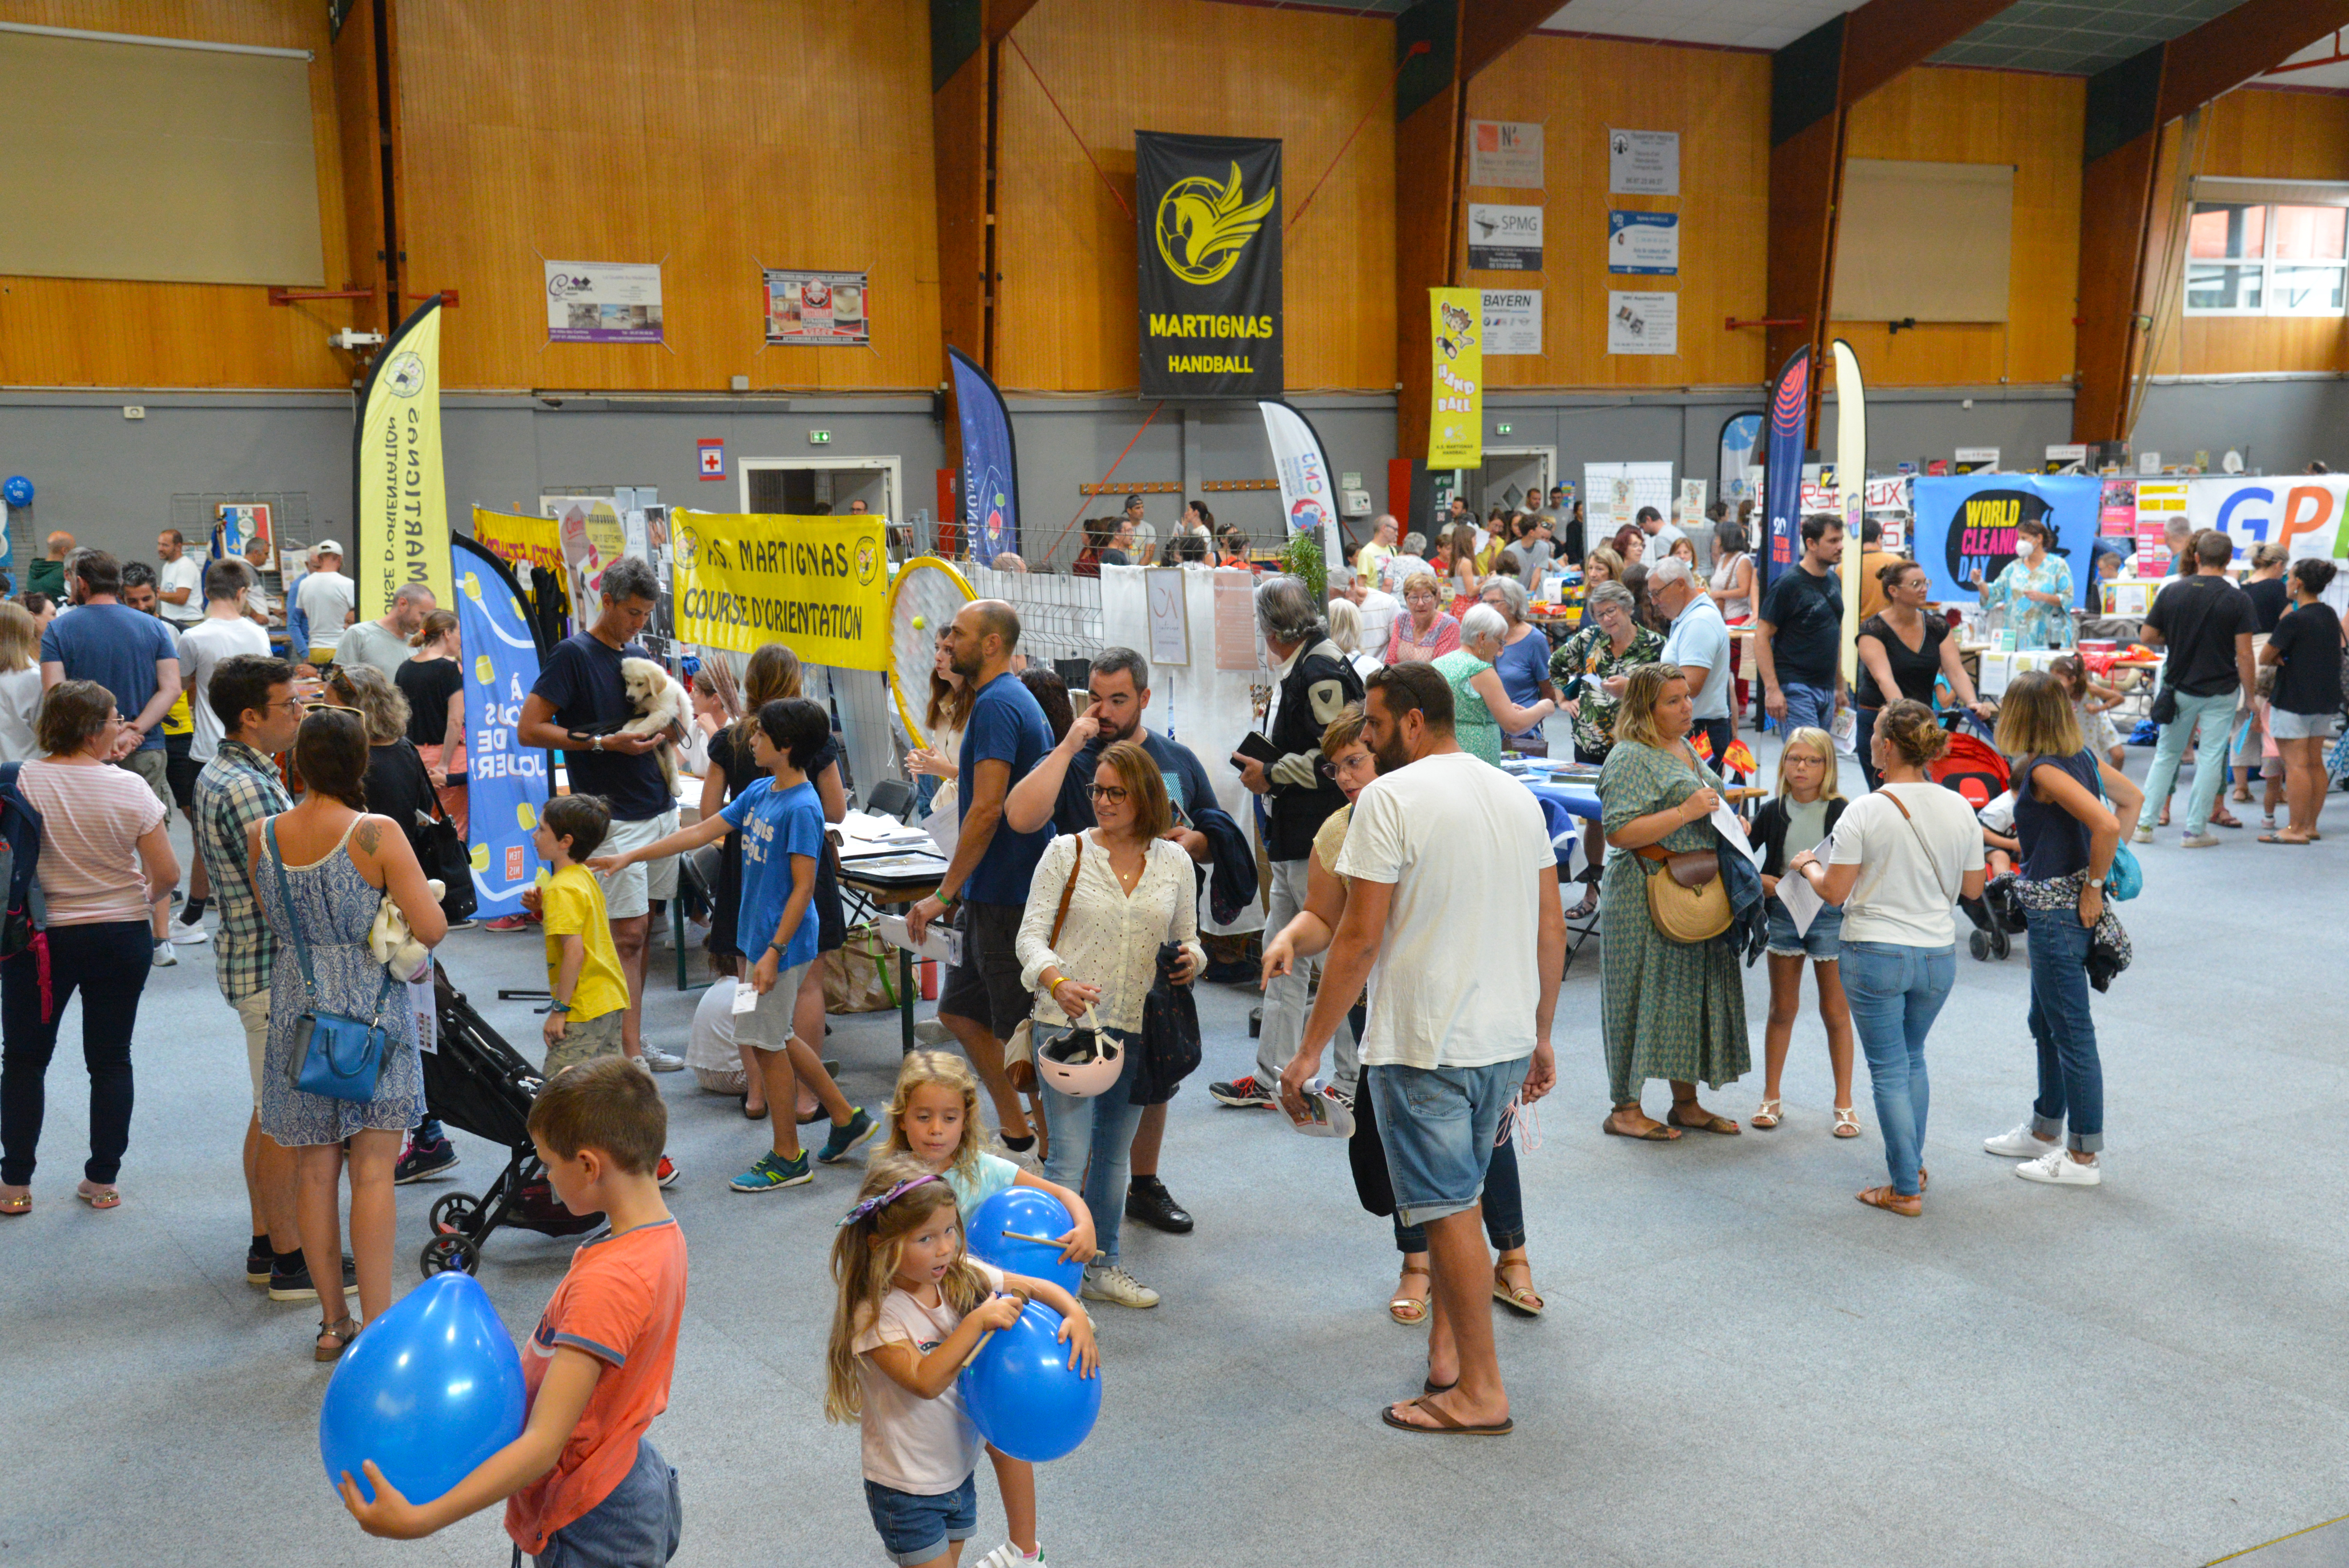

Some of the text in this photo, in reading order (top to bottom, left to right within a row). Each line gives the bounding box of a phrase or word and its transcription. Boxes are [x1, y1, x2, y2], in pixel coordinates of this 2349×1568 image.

[1502, 216, 1537, 231] SPMG
[1484, 295, 1531, 306] BAYERN
[1150, 314, 1273, 339] MARTIGNAS
[1168, 355, 1253, 373] HANDBALL
[1438, 363, 1475, 396] HAND
[1438, 396, 1472, 413] BALL
[1966, 499, 2020, 528] WORLD
[1961, 528, 2019, 555] CLEANU
[739, 540, 848, 577] MARTIGNAS
[684, 587, 862, 641] COURSE D'ORIENTATION
